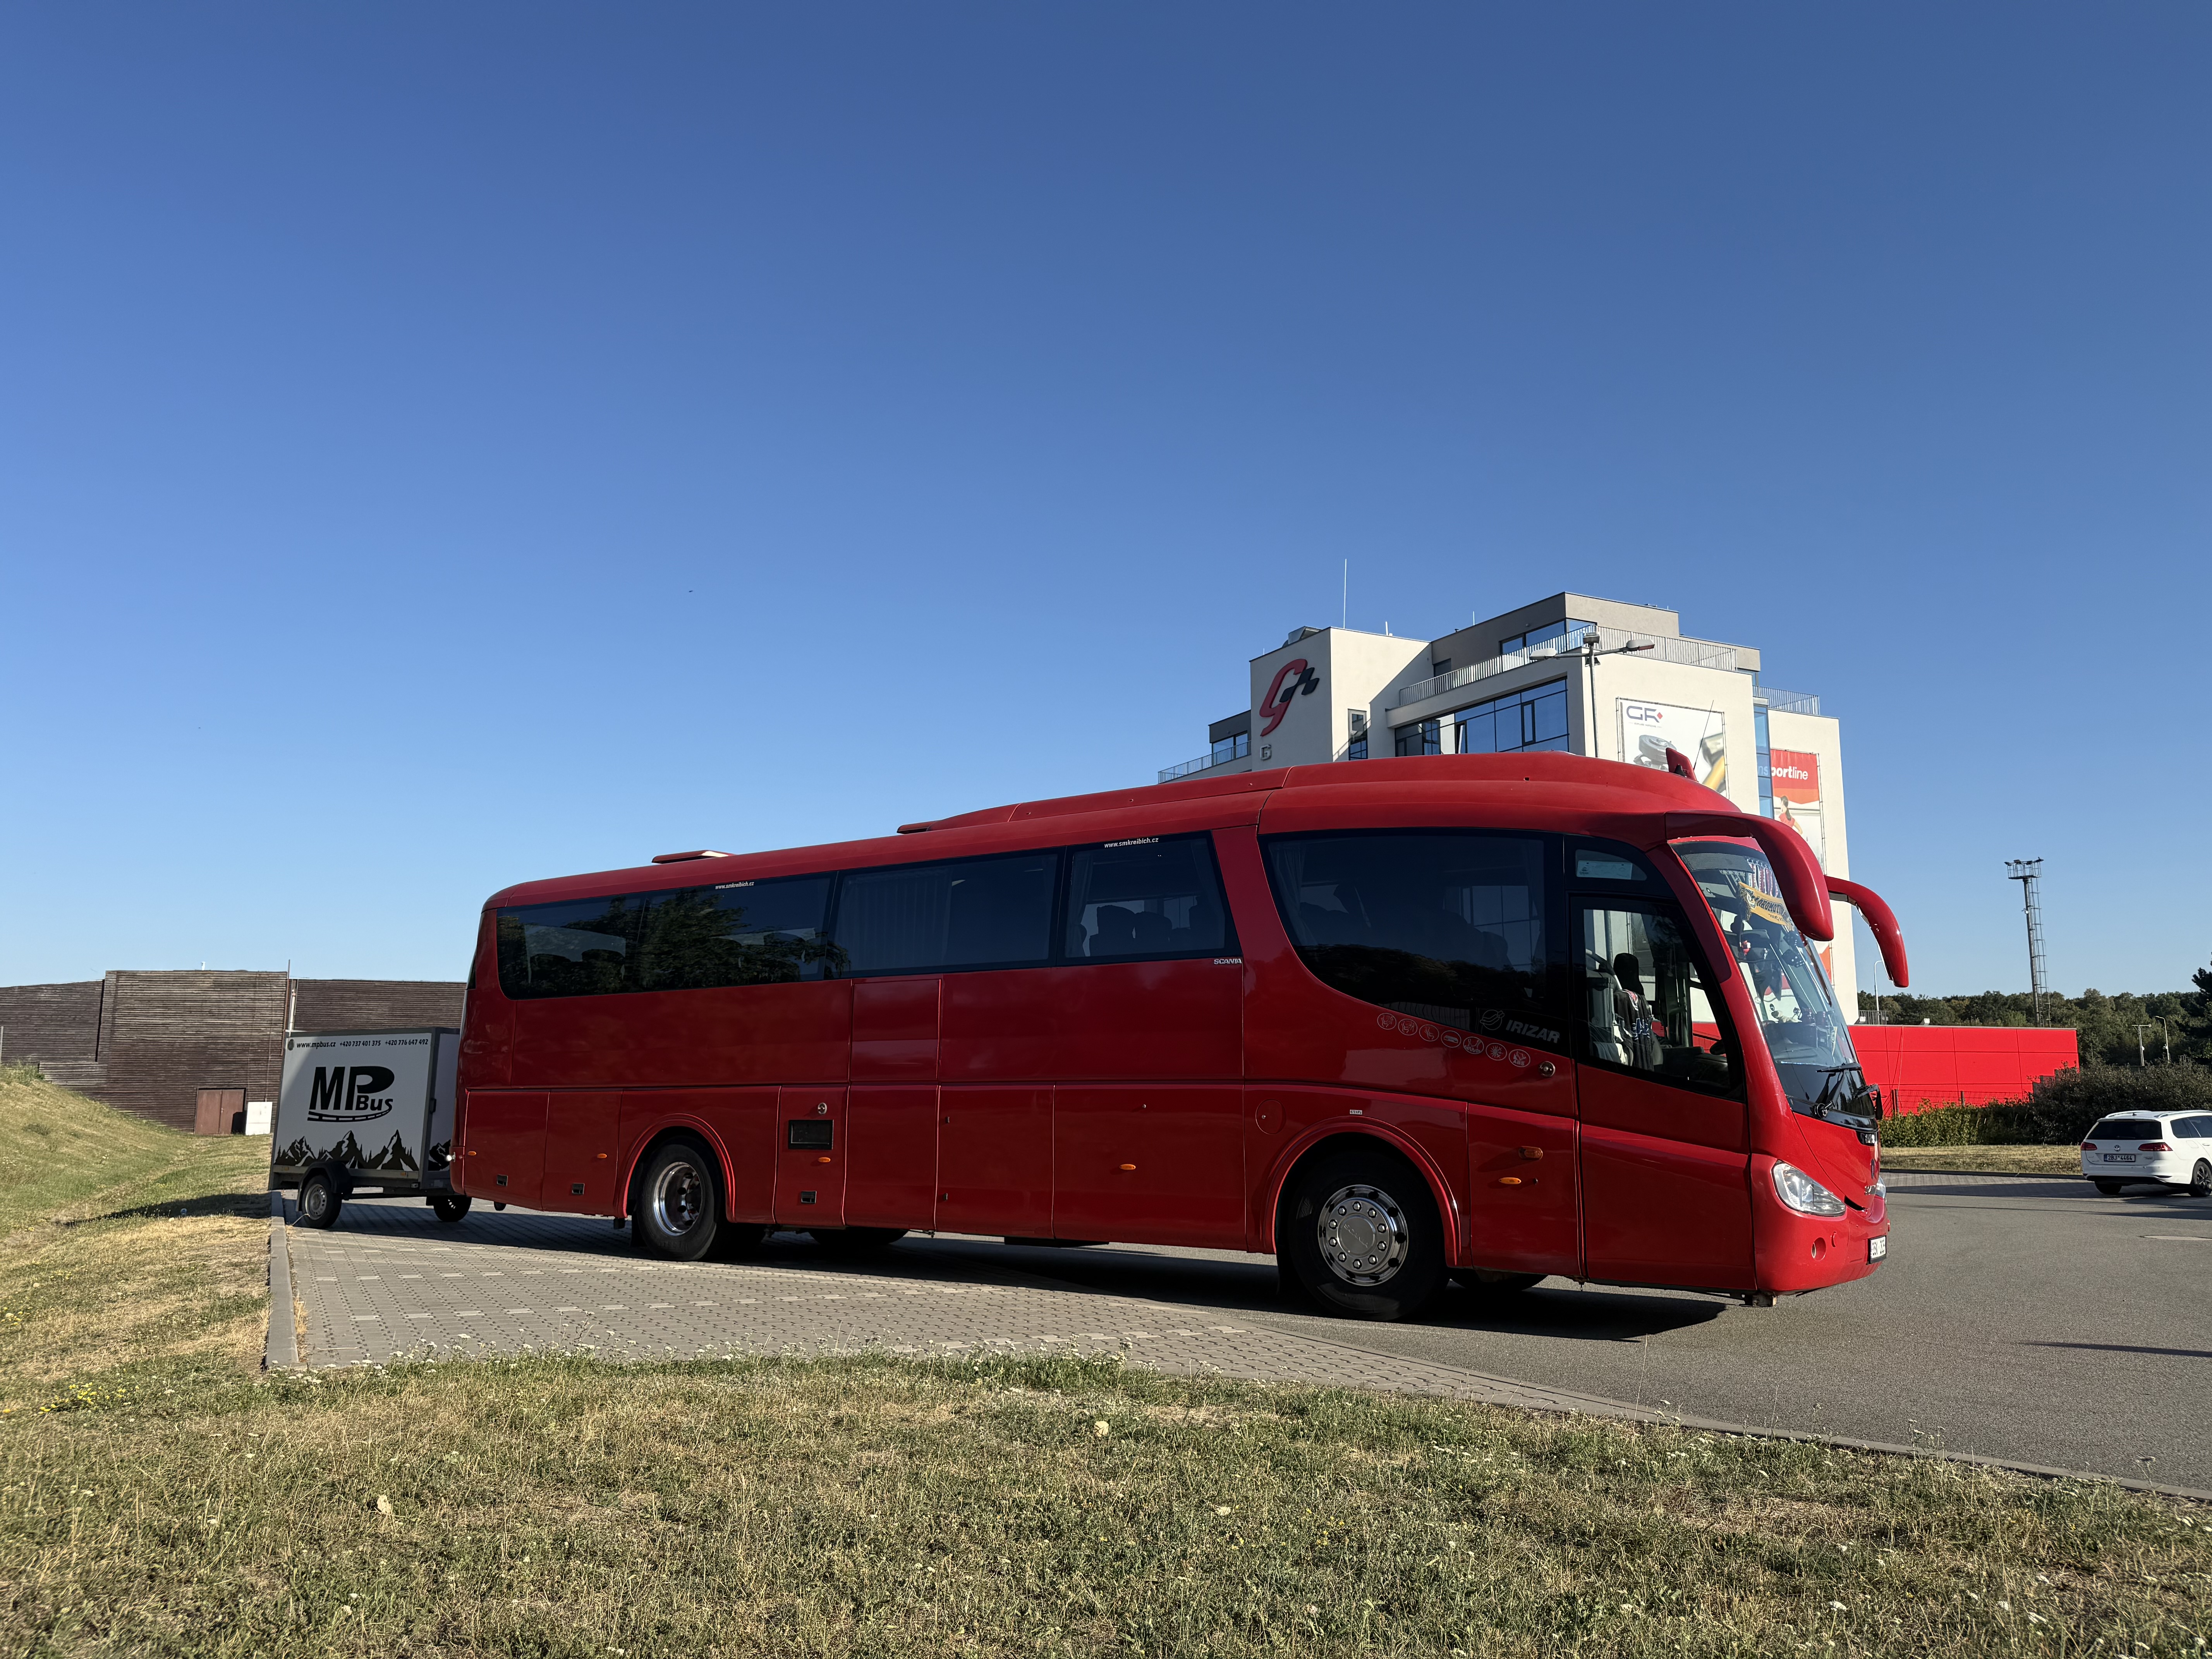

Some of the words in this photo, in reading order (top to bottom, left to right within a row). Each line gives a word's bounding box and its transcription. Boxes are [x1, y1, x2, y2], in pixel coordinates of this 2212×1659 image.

[1104, 837, 1159, 848] www.smkreibich.cz
[1506, 1020, 1560, 1043] IRIZAR
[297, 1041, 336, 1049] www.mpbus.cz
[309, 1066, 395, 1111] MP
[356, 1095, 393, 1111] Bus
